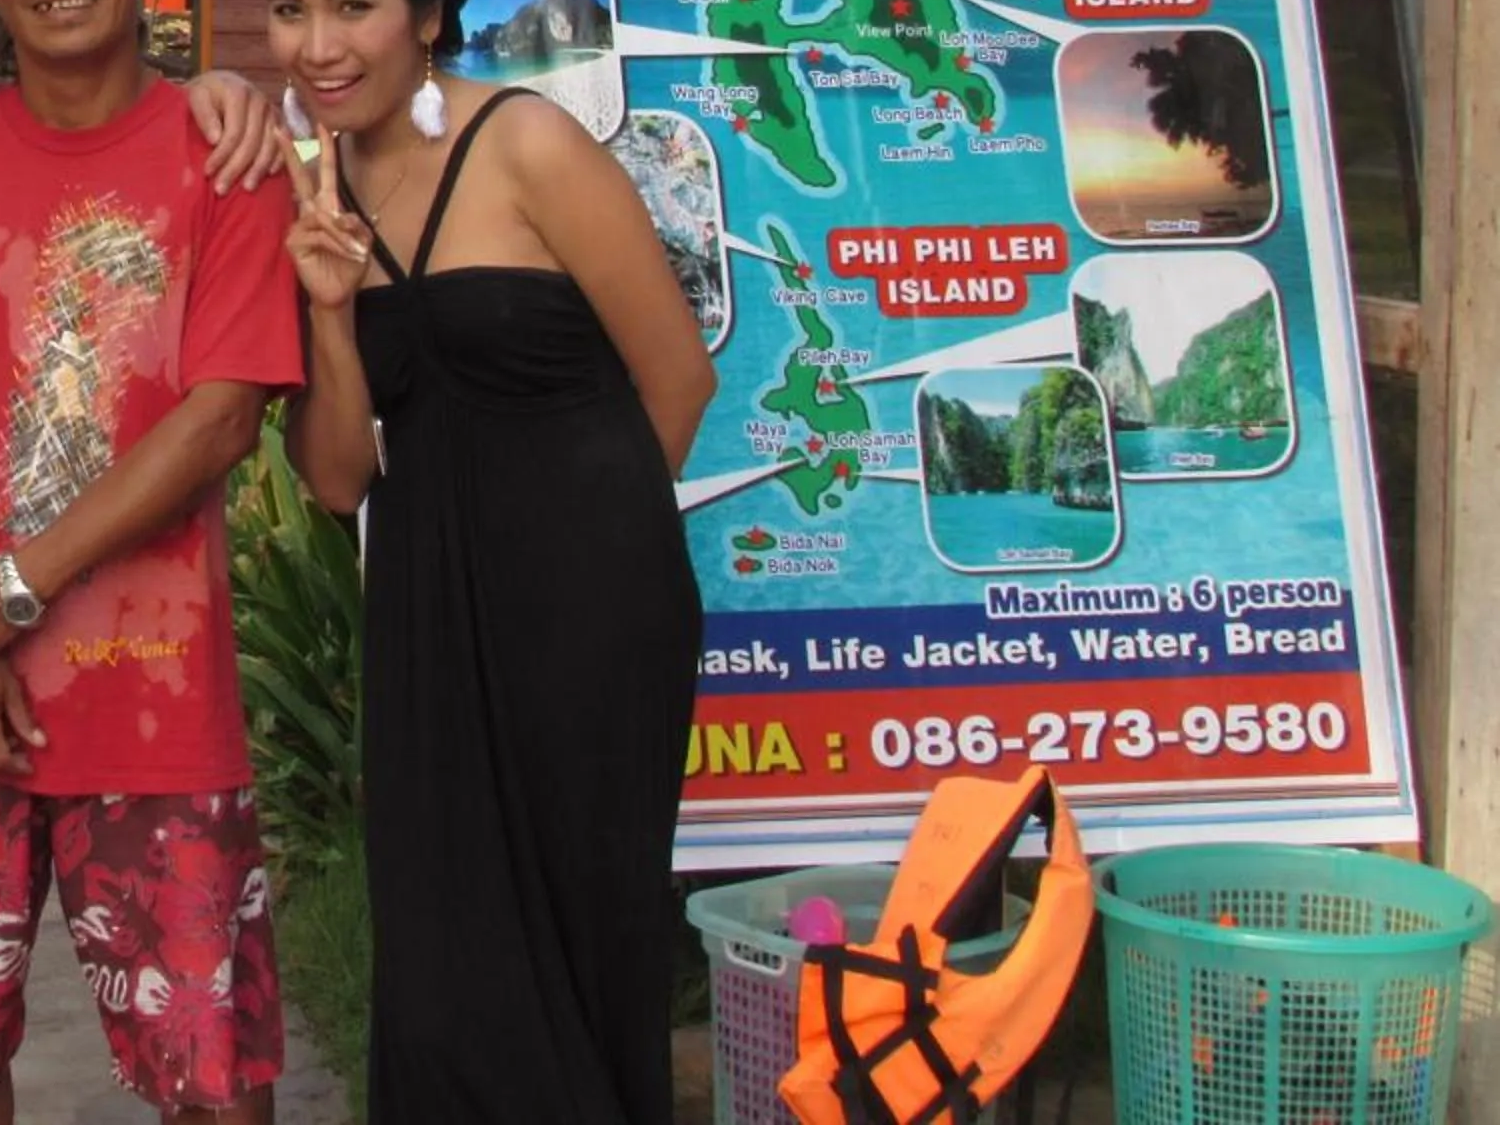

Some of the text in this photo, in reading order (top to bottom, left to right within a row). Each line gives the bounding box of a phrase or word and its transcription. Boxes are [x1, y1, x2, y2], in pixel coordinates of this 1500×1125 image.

[855, 23, 932, 38] View Point
[978, 49, 1006, 64] Bay
[812, 72, 838, 87] Ton
[871, 72, 898, 89] Bay
[672, 85, 758, 102] Wang Long
[702, 101, 731, 117] Bay
[872, 106, 963, 123] Long Beach
[881, 146, 924, 160] Laem
[970, 138, 1012, 152] Laem
[838, 235, 1056, 265] PHI PHI LEH
[772, 287, 867, 306] Viking Cave
[887, 277, 1016, 304] ISLAND
[842, 349, 871, 366] Bay
[746, 422, 788, 439] Maya
[753, 438, 782, 454] Bay
[828, 433, 859, 448] Loh
[860, 449, 889, 465] Bay
[779, 534, 812, 550] Bida
[768, 558, 837, 573] Bida Nok
[989, 585, 1156, 618] Maximum
[1192, 579, 1215, 609] 6
[1226, 577, 1338, 614] person
[698, 622, 1346, 680] ask, Life Jacket, Water, Bread
[870, 702, 1347, 768] 086-273-9580
